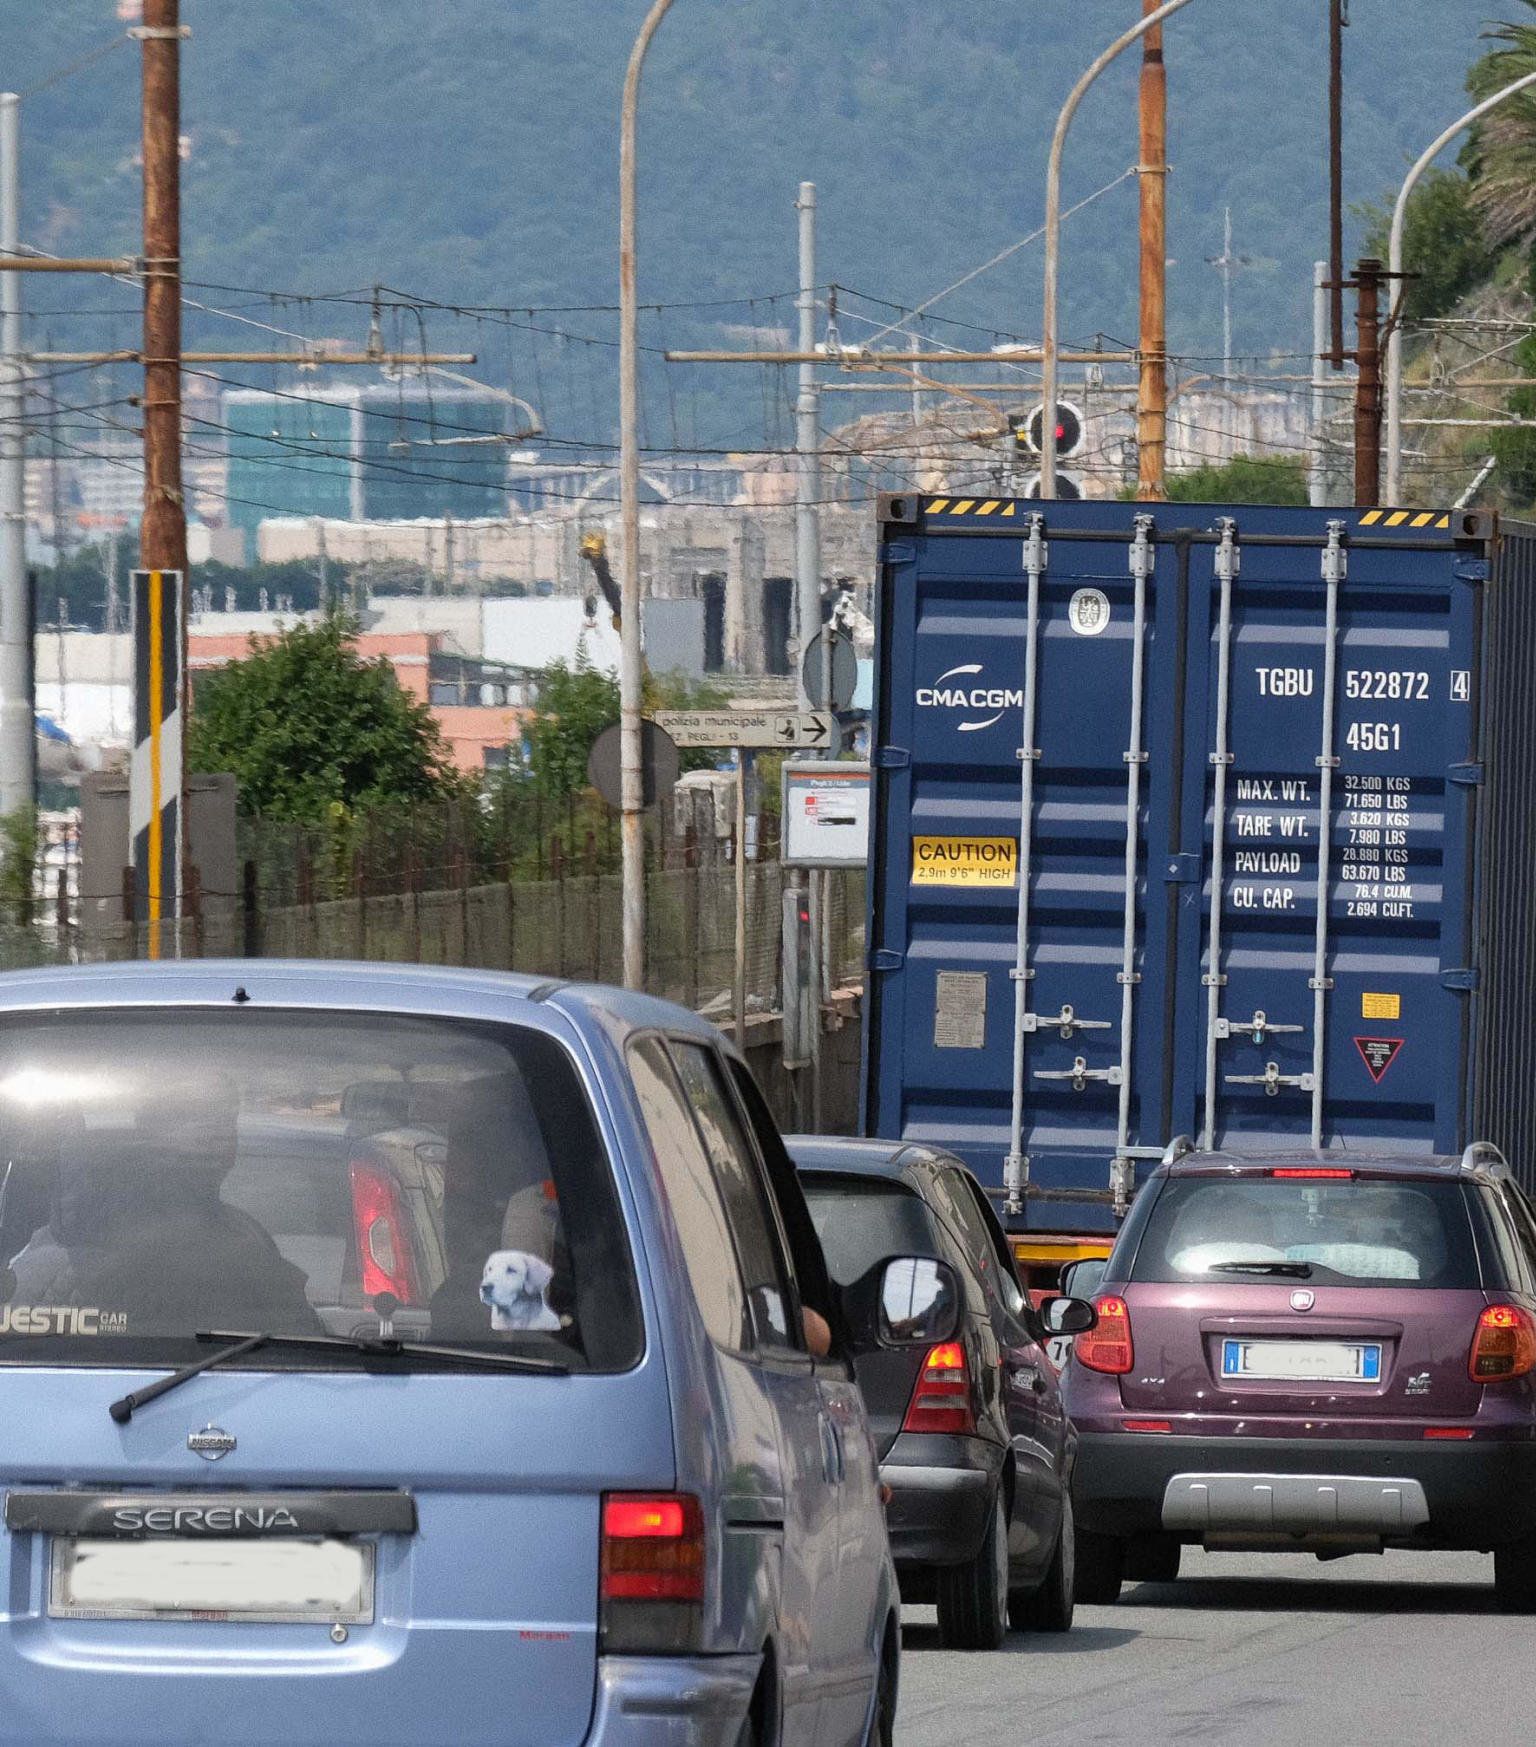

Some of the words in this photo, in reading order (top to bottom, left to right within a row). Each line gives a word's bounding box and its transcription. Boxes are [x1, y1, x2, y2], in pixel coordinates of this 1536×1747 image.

[1255, 668, 1313, 696] TGBU
[1346, 671, 1429, 699] 522872
[1453, 672, 1467, 699] 4
[1346, 723, 1400, 751] 45G1
[1237, 779, 1279, 800] MAX.
[1282, 781, 1311, 801] WT.
[1345, 776, 1381, 790] 32.500
[1387, 777, 1410, 790] KGS
[1345, 794, 1381, 808] 71.650
[1387, 795, 1408, 809] LBS
[1236, 814, 1272, 836] TARE
[1280, 816, 1309, 837] WT.
[1350, 812, 1381, 825] 3.620
[1386, 813, 1410, 826] KGS
[1349, 829, 1380, 844] 7.980
[1385, 830, 1406, 845] LBS
[918, 842, 1011, 862] CAUTION
[1385, 849, 1408, 863] KGS
[1235, 852, 1300, 873] PAYLOAD
[979, 868, 1011, 880] HIGH
[1342, 865, 1379, 880] 63.670
[1385, 866, 1406, 881] LBS
[1233, 887, 1258, 908] CU.
[1263, 887, 1295, 909] CAP.
[1355, 884, 1379, 898] 76.4
[1347, 902, 1378, 916] 2.694
[100, 1312, 128, 1325] CAR
[113, 1507, 299, 1530] SERENA
